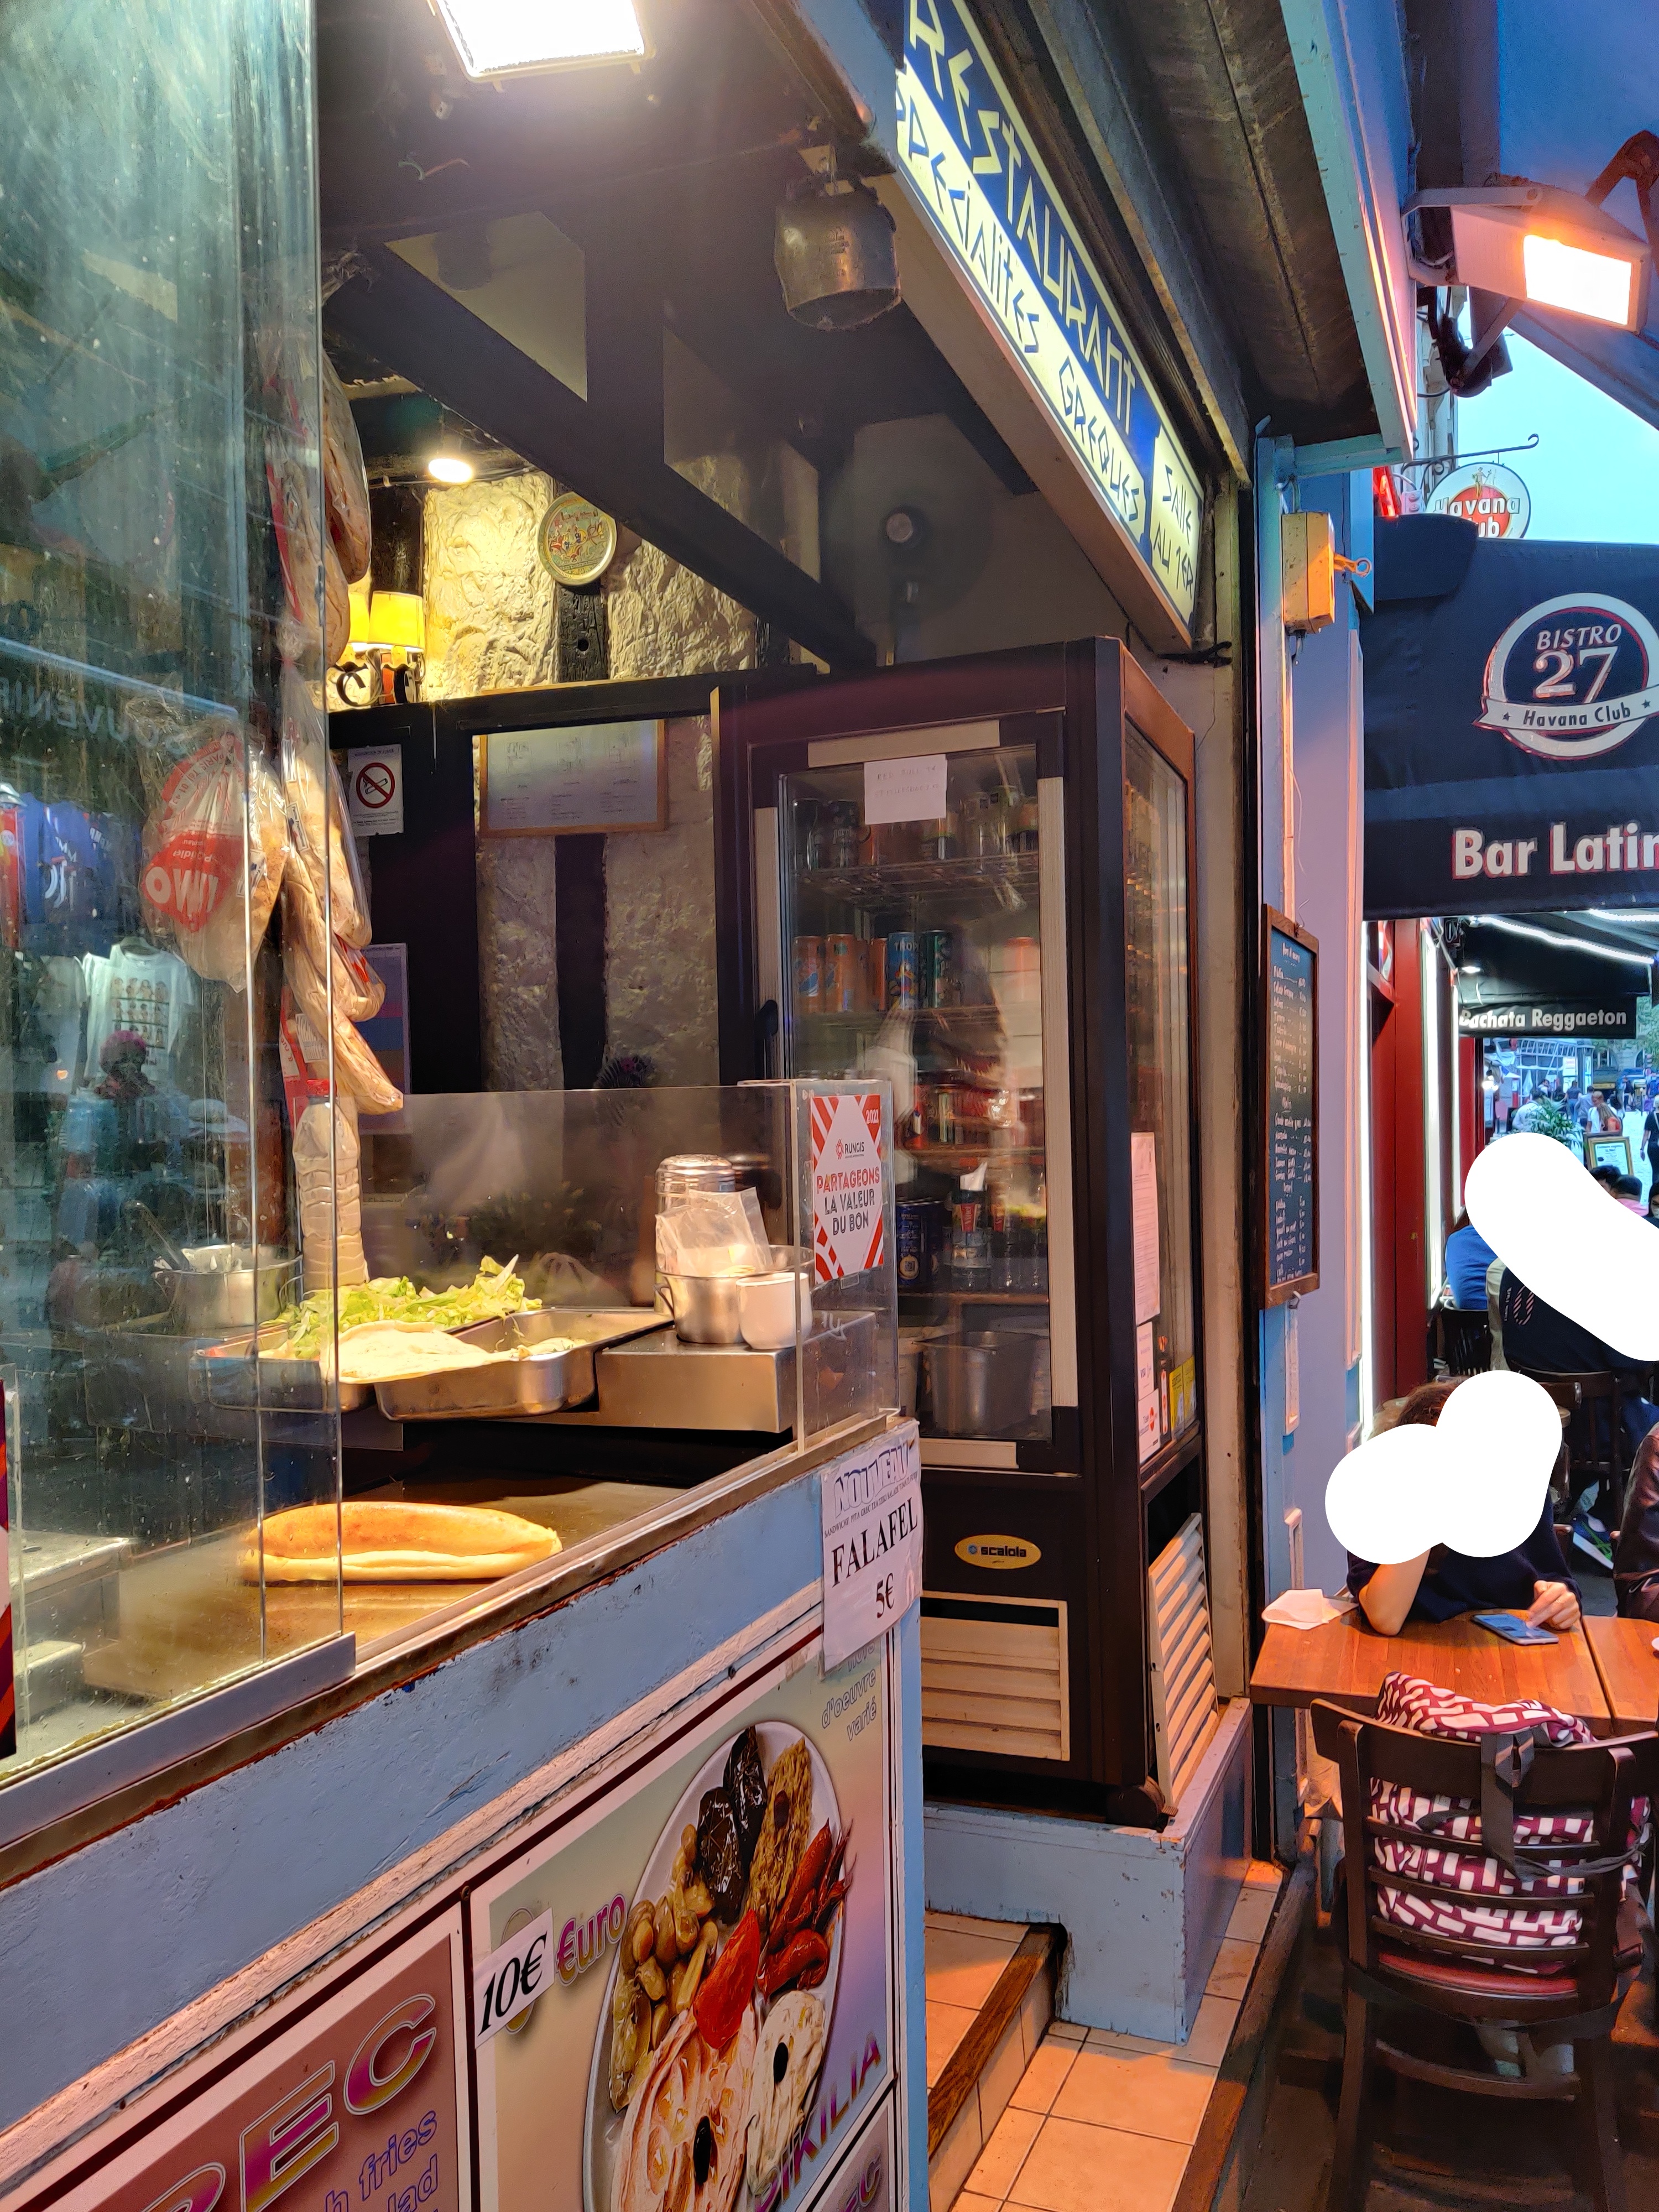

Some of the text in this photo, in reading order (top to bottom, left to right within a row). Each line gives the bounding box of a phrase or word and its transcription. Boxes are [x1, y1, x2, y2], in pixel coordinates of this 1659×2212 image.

[910, 0, 1136, 436] RESTAURANT
[1433, 497, 1520, 517] Havana
[1470, 516, 1500, 537] ub
[1536, 623, 1622, 651] BISTRO
[1533, 645, 1619, 704] 27
[1523, 702, 1631, 727] Havana Club
[1452, 828, 1538, 879] Bar
[1459, 1006, 1627, 1031] Bachata Reggaeton
[865, 1108, 879, 1124] 2021
[844, 1141, 865, 1156] RUNGIS
[817, 1166, 880, 1194] PARTAGEONS
[825, 1188, 875, 1215] LA VALEUR
[833, 1209, 869, 1236] DU BON
[834, 1447, 910, 1519] NOUVEAU
[851, 1512, 860, 1523] PITA
[831, 1496, 918, 1588] FALAFEL
[875, 1572, 895, 1619] 5€
[822, 1668, 876, 1729] d'oeuvre
[846, 1695, 877, 1741] varié
[477, 1929, 548, 2037] 10€
[359, 2110, 437, 2202] fries
